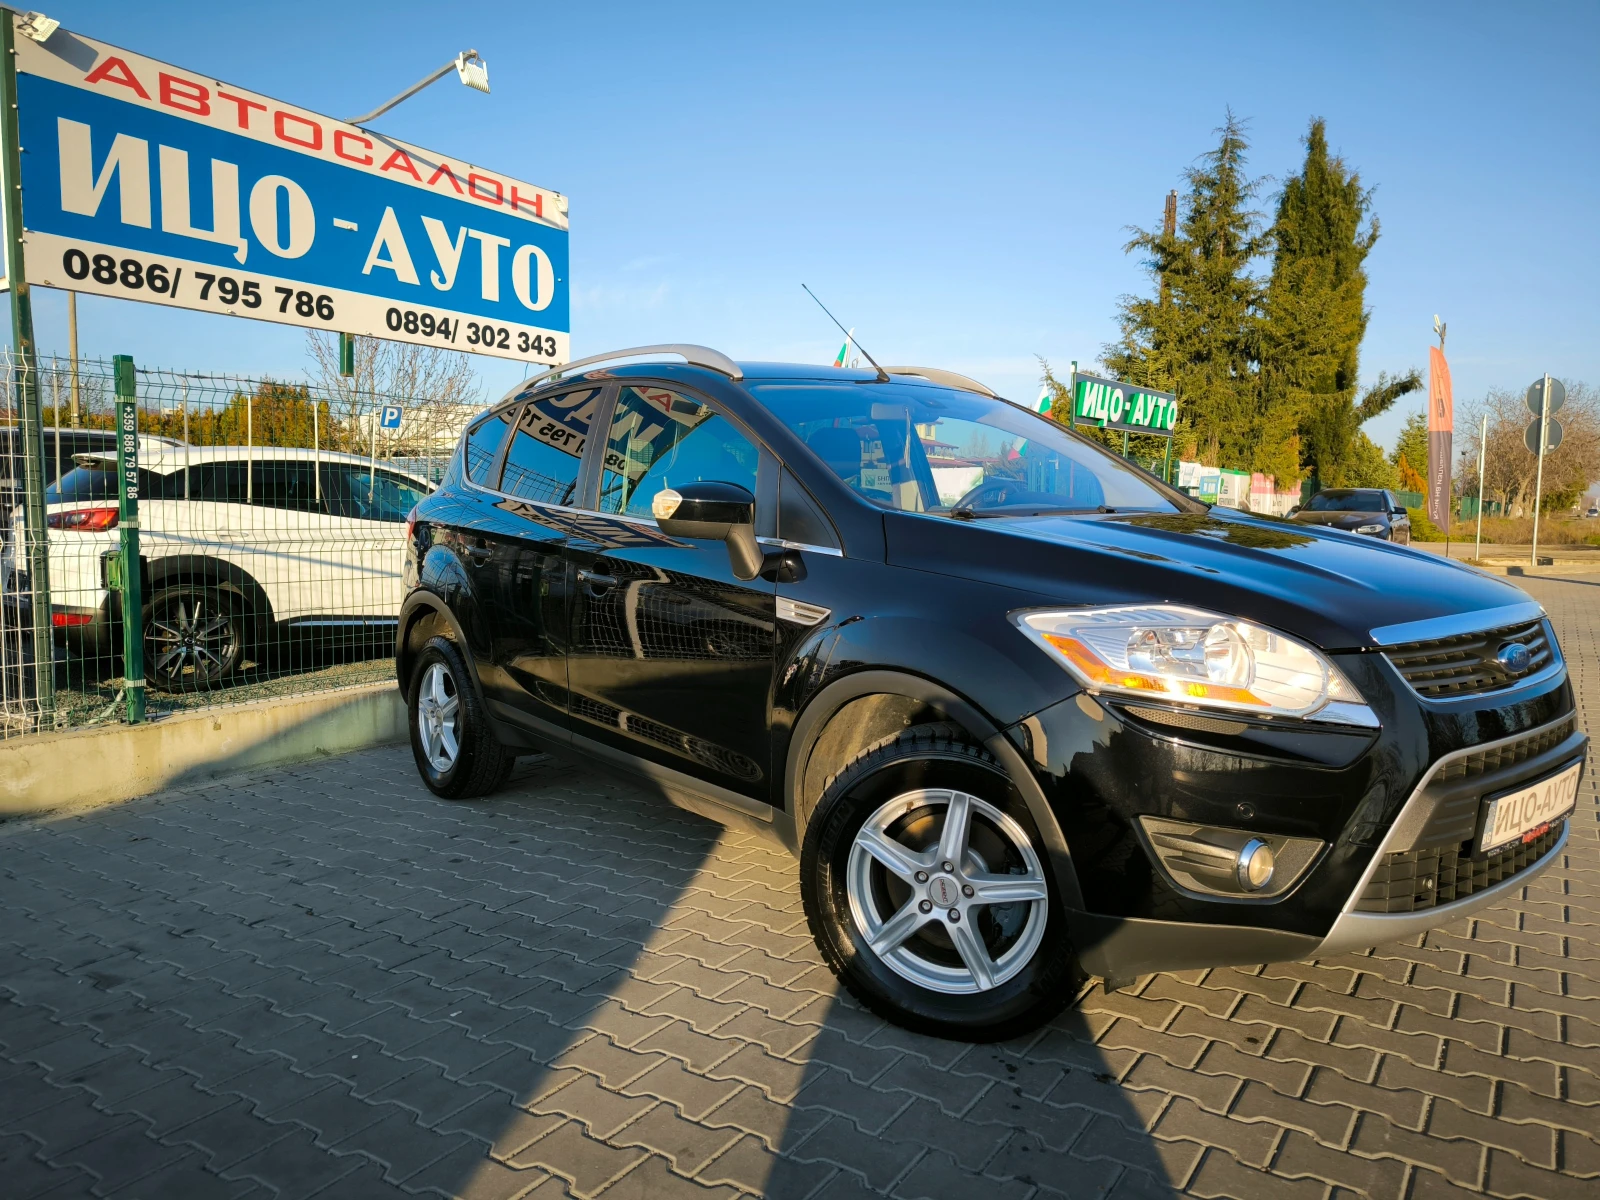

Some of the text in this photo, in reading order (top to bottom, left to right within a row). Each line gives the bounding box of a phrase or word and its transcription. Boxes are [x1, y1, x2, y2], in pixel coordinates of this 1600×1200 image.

[84, 56, 543, 218] АВТОСАЛОН
[194, 271, 262, 309] 795
[274, 286, 335, 321] 786
[466, 322, 511, 351] 302
[517, 331, 557, 358] 343
[384, 407, 398, 425] P
[123, 406, 138, 500] +359 886 79 57 86
[1495, 771, 1577, 836] ИЦО-АУТО
